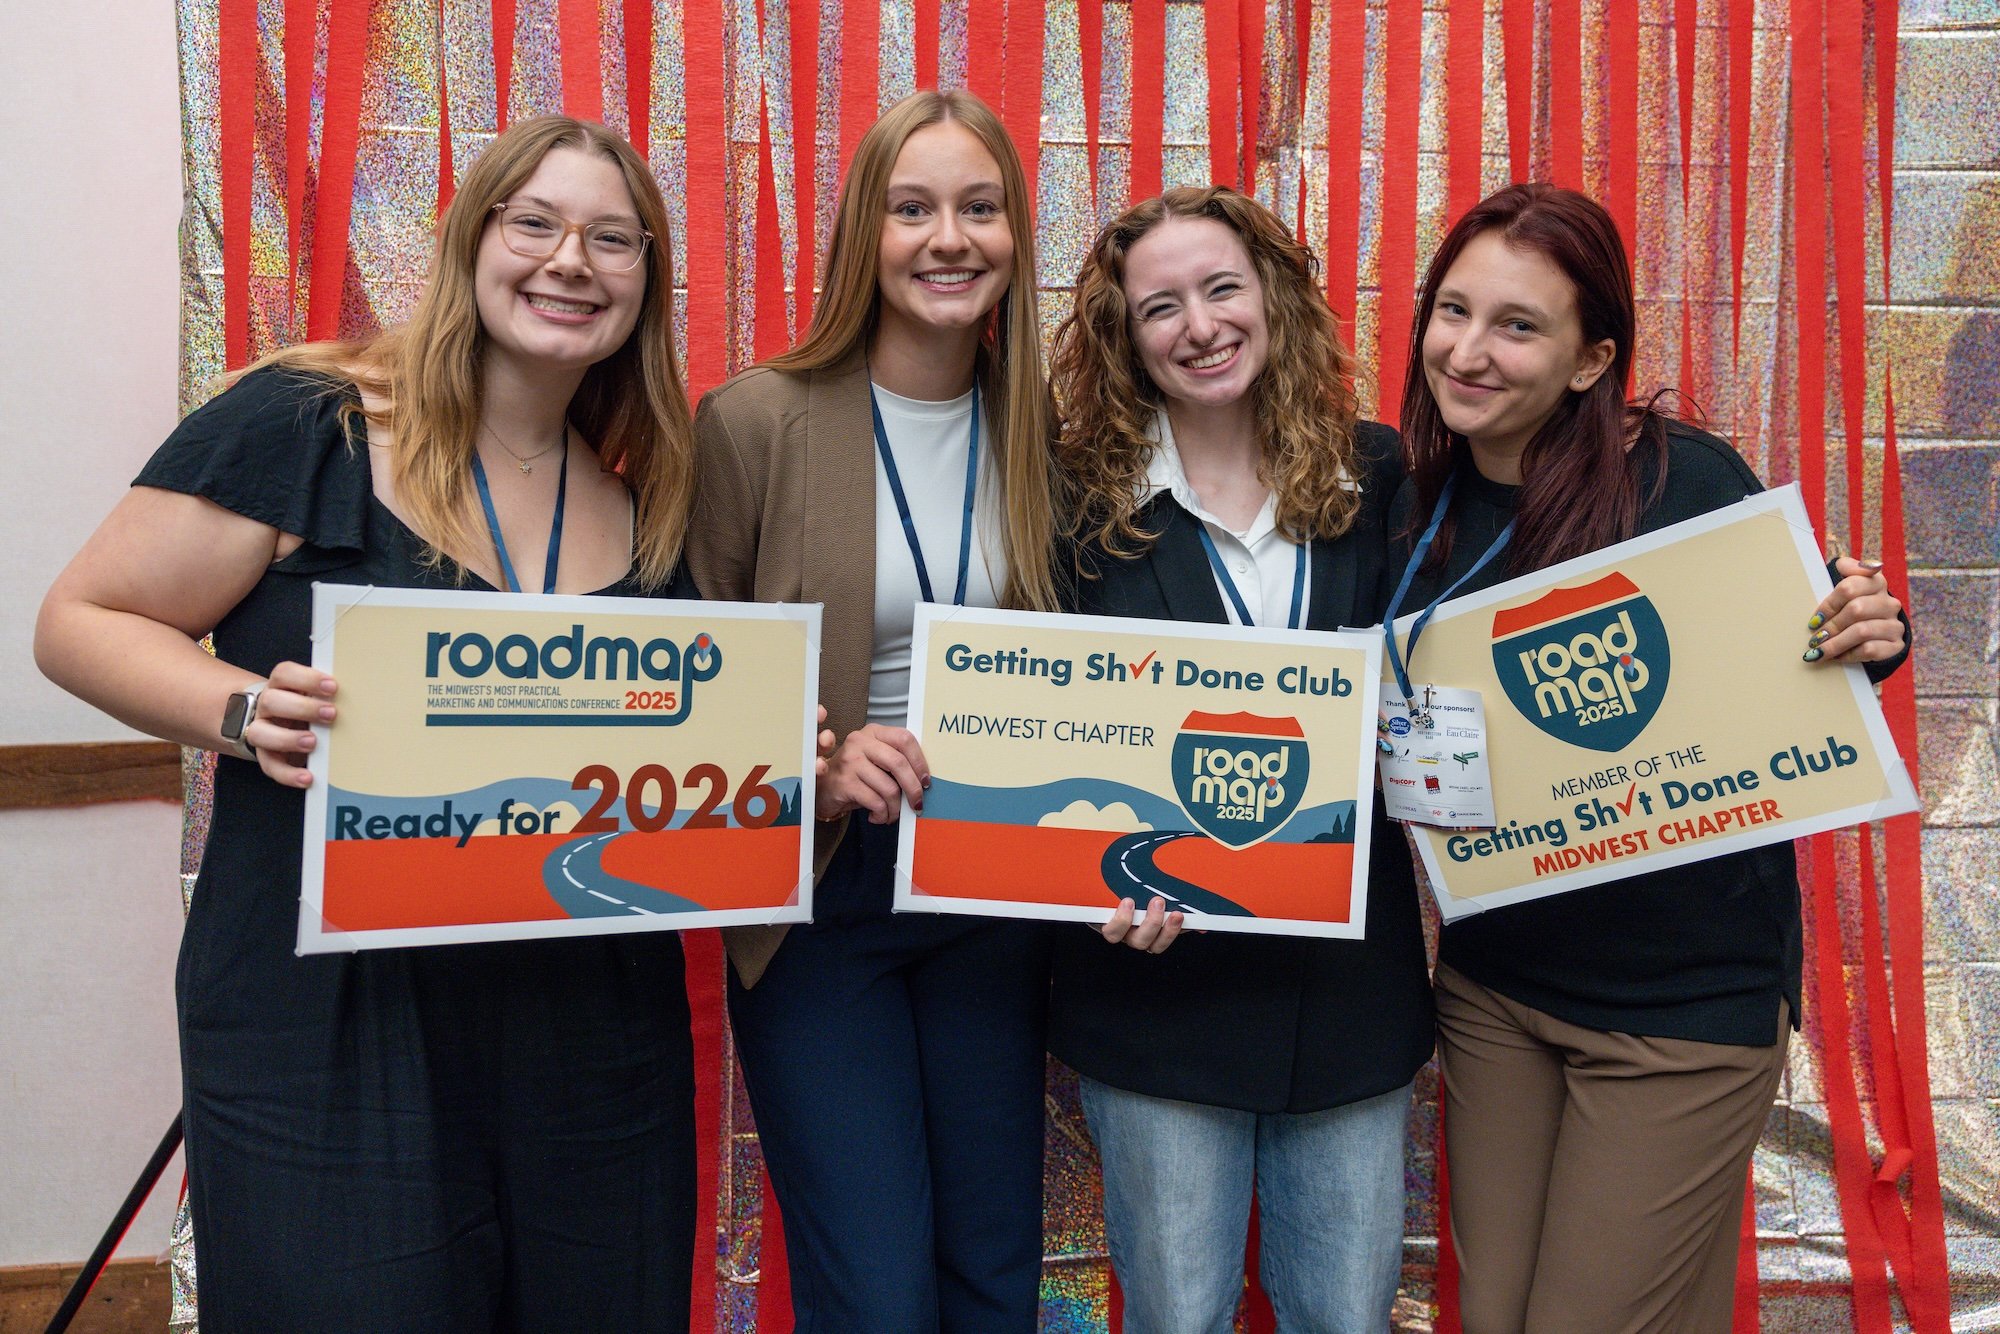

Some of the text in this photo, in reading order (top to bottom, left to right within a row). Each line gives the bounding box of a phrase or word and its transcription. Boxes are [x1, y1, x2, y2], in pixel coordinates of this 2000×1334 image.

[425, 624, 723, 700] roadmap
[1518, 609, 1639, 686] road
[428, 684, 561, 696] THE MIDWEST'S MOST PRACTICAL
[945, 643, 1073, 687] Getting
[1175, 659, 1265, 692] Done
[1276, 667, 1353, 698] Club
[1534, 658, 1650, 720] map
[427, 697, 621, 710] MARKETING AND COMMUNICATIONS CONFERENCE
[624, 691, 678, 710] 2025
[1444, 705, 1475, 713] sponsors!
[1574, 698, 1625, 728] 2025
[938, 713, 1155, 747] MIDWEST CHAPTER
[1192, 745, 1290, 780] road
[1389, 777, 1416, 786] DigiCOPY
[1550, 744, 1707, 801] MEMBER OF THE
[335, 763, 782, 848] Ready for 2026
[1191, 774, 1286, 823] map
[1216, 804, 1255, 822] 2025
[1446, 815, 1568, 864] Getting
[1662, 766, 1760, 811] Done
[1769, 736, 1859, 782] Club
[1532, 798, 1783, 877] MIDWEST CHAPTER
